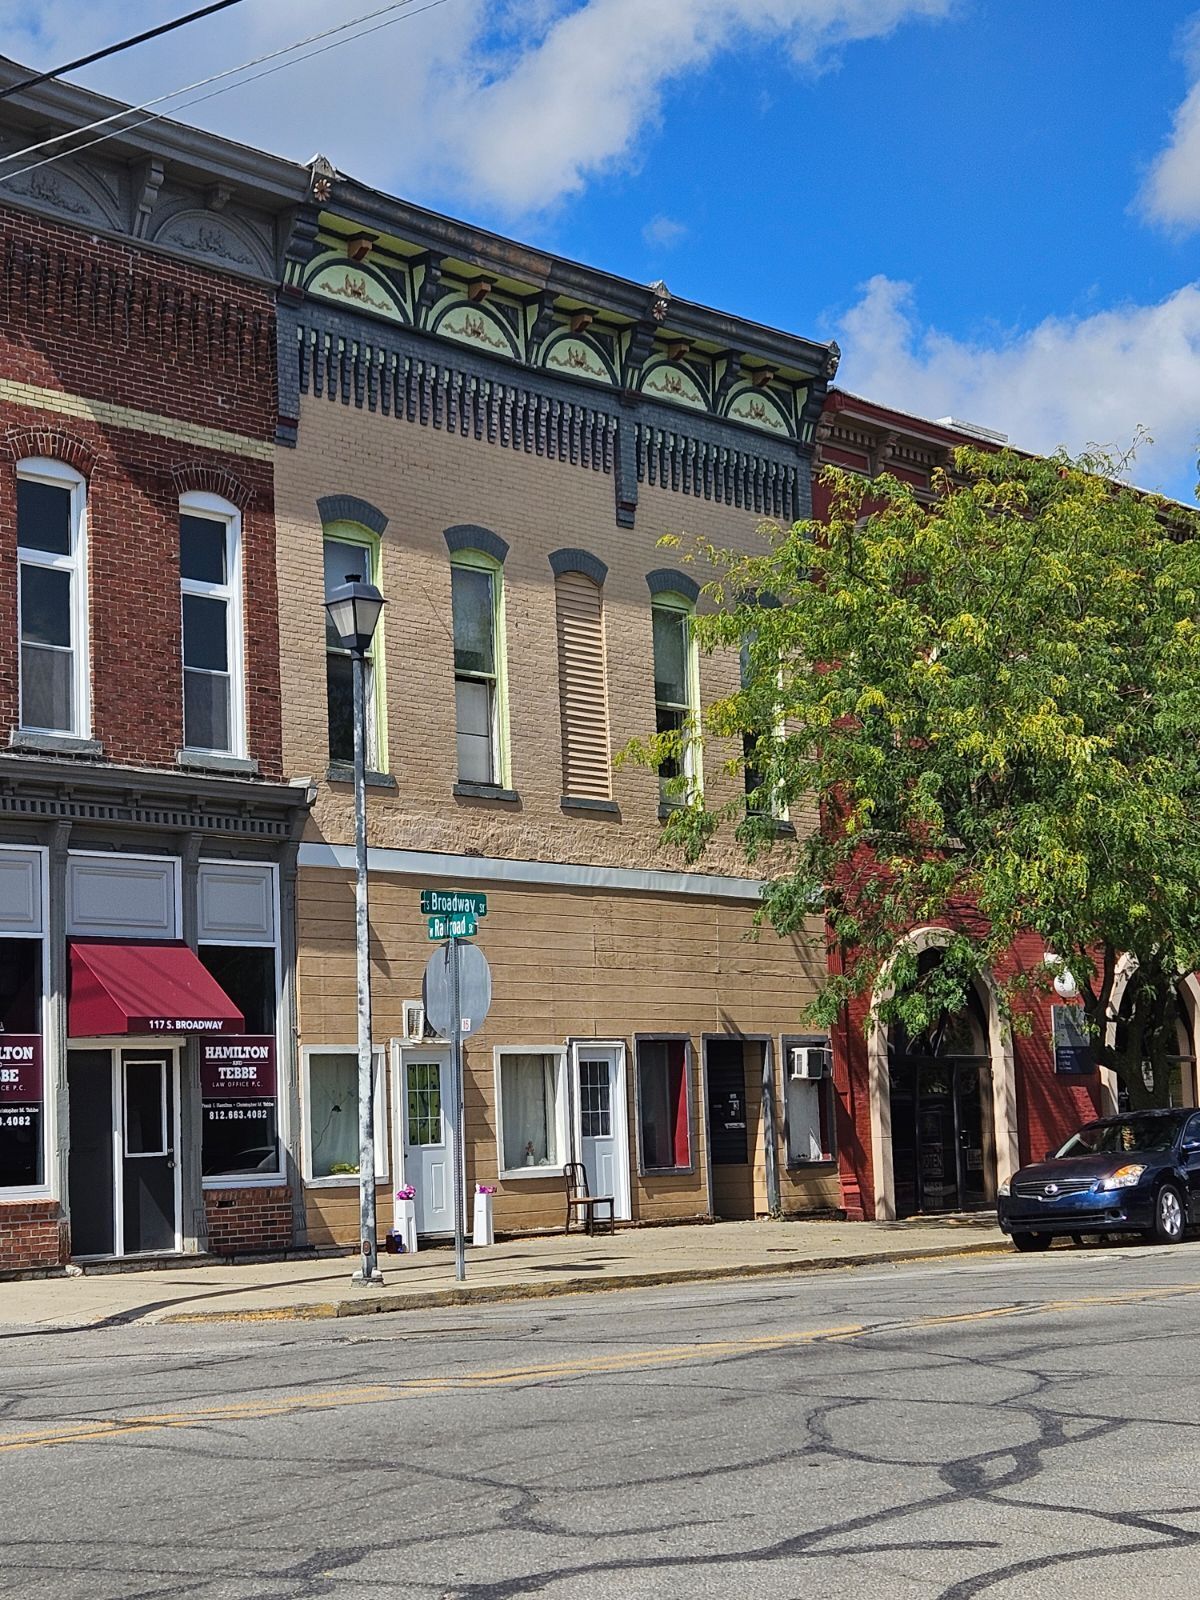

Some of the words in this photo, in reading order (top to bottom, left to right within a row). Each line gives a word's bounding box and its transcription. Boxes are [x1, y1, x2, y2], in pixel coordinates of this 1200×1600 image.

[431, 892, 476, 914] Broadway
[434, 915, 466, 937] Railroad
[149, 1020, 165, 1029] 117
[166, 1020, 174, 1029] S.
[175, 1020, 223, 1030] BROADWAY
[205, 1046, 269, 1059] HAMILTON
[218, 1066, 257, 1079] TEBBE
[209, 1110, 267, 1120] 812.663.4082
